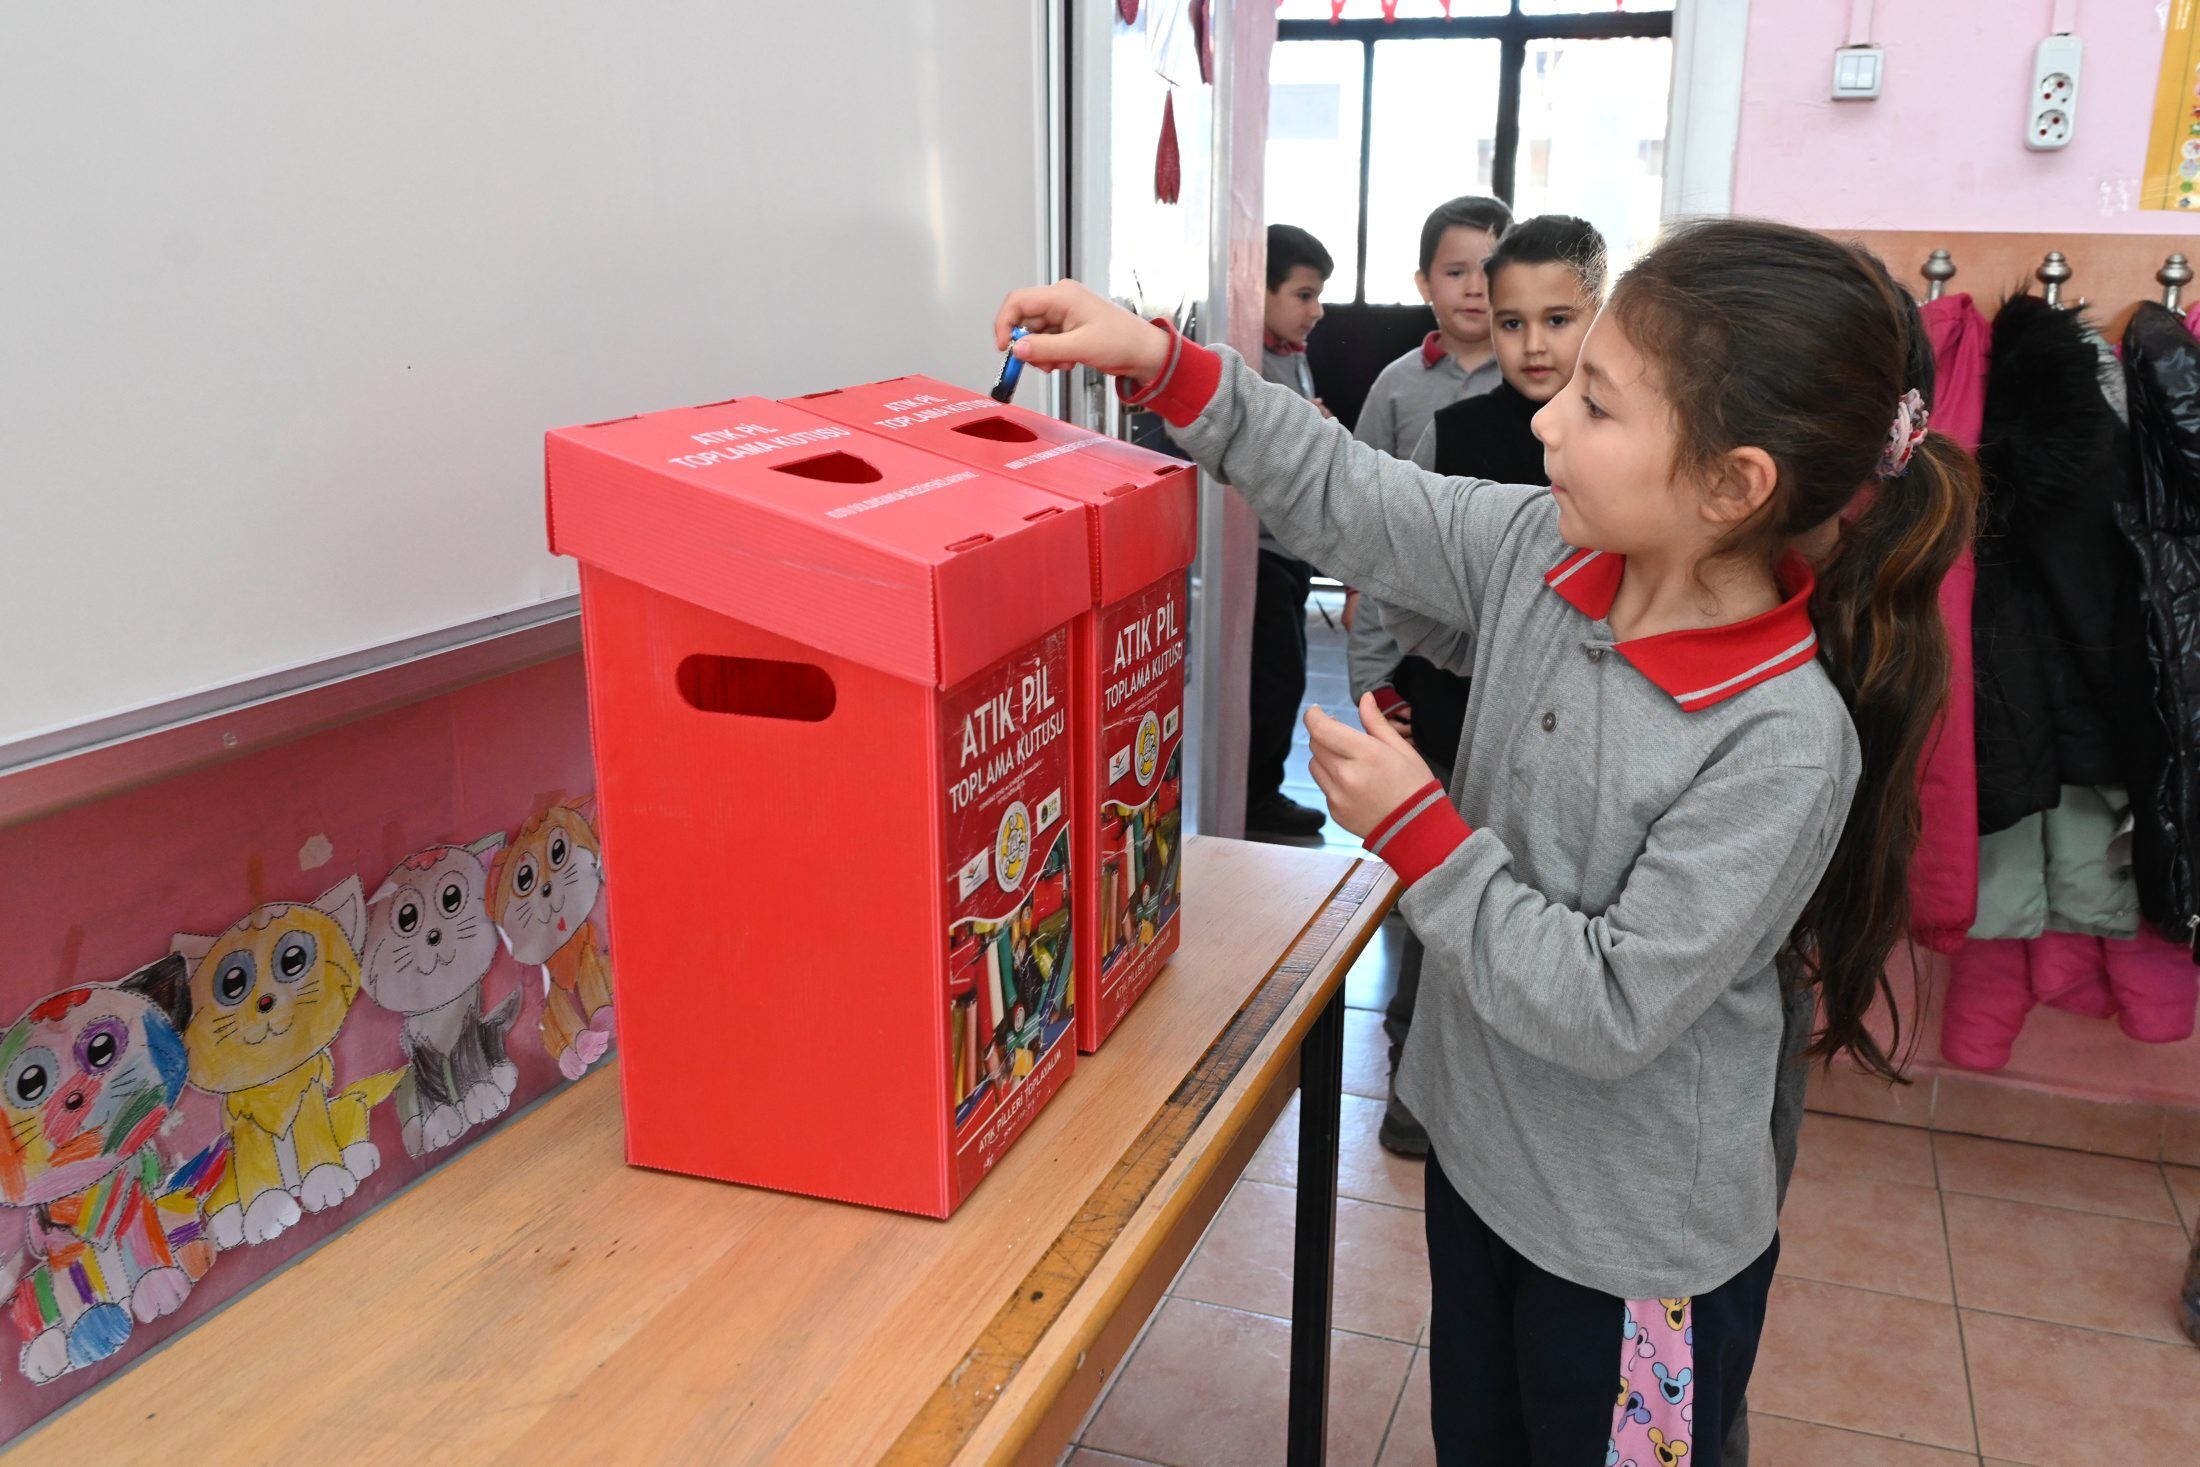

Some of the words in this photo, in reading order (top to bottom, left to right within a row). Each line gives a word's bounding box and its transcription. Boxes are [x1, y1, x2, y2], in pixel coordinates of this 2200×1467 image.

[873, 408, 949, 430] TOPLAMA
[883, 398, 918, 412] ATIK
[668, 441, 783, 468] TOPLAMA
[768, 426, 852, 447] KUTUSU
[690, 428, 737, 446] ATIK
[734, 422, 780, 438] PİL
[1113, 613, 1152, 675] ATIK
[1157, 592, 1178, 648] PİL
[1105, 663, 1151, 711] TOPLAMA
[1152, 641, 1183, 681] KUTUSU
[960, 687, 1016, 768] ATIK
[1021, 657, 1055, 724] PİL
[949, 746, 1015, 814] TOPLAMA
[1016, 708, 1065, 765] KUTUSU
